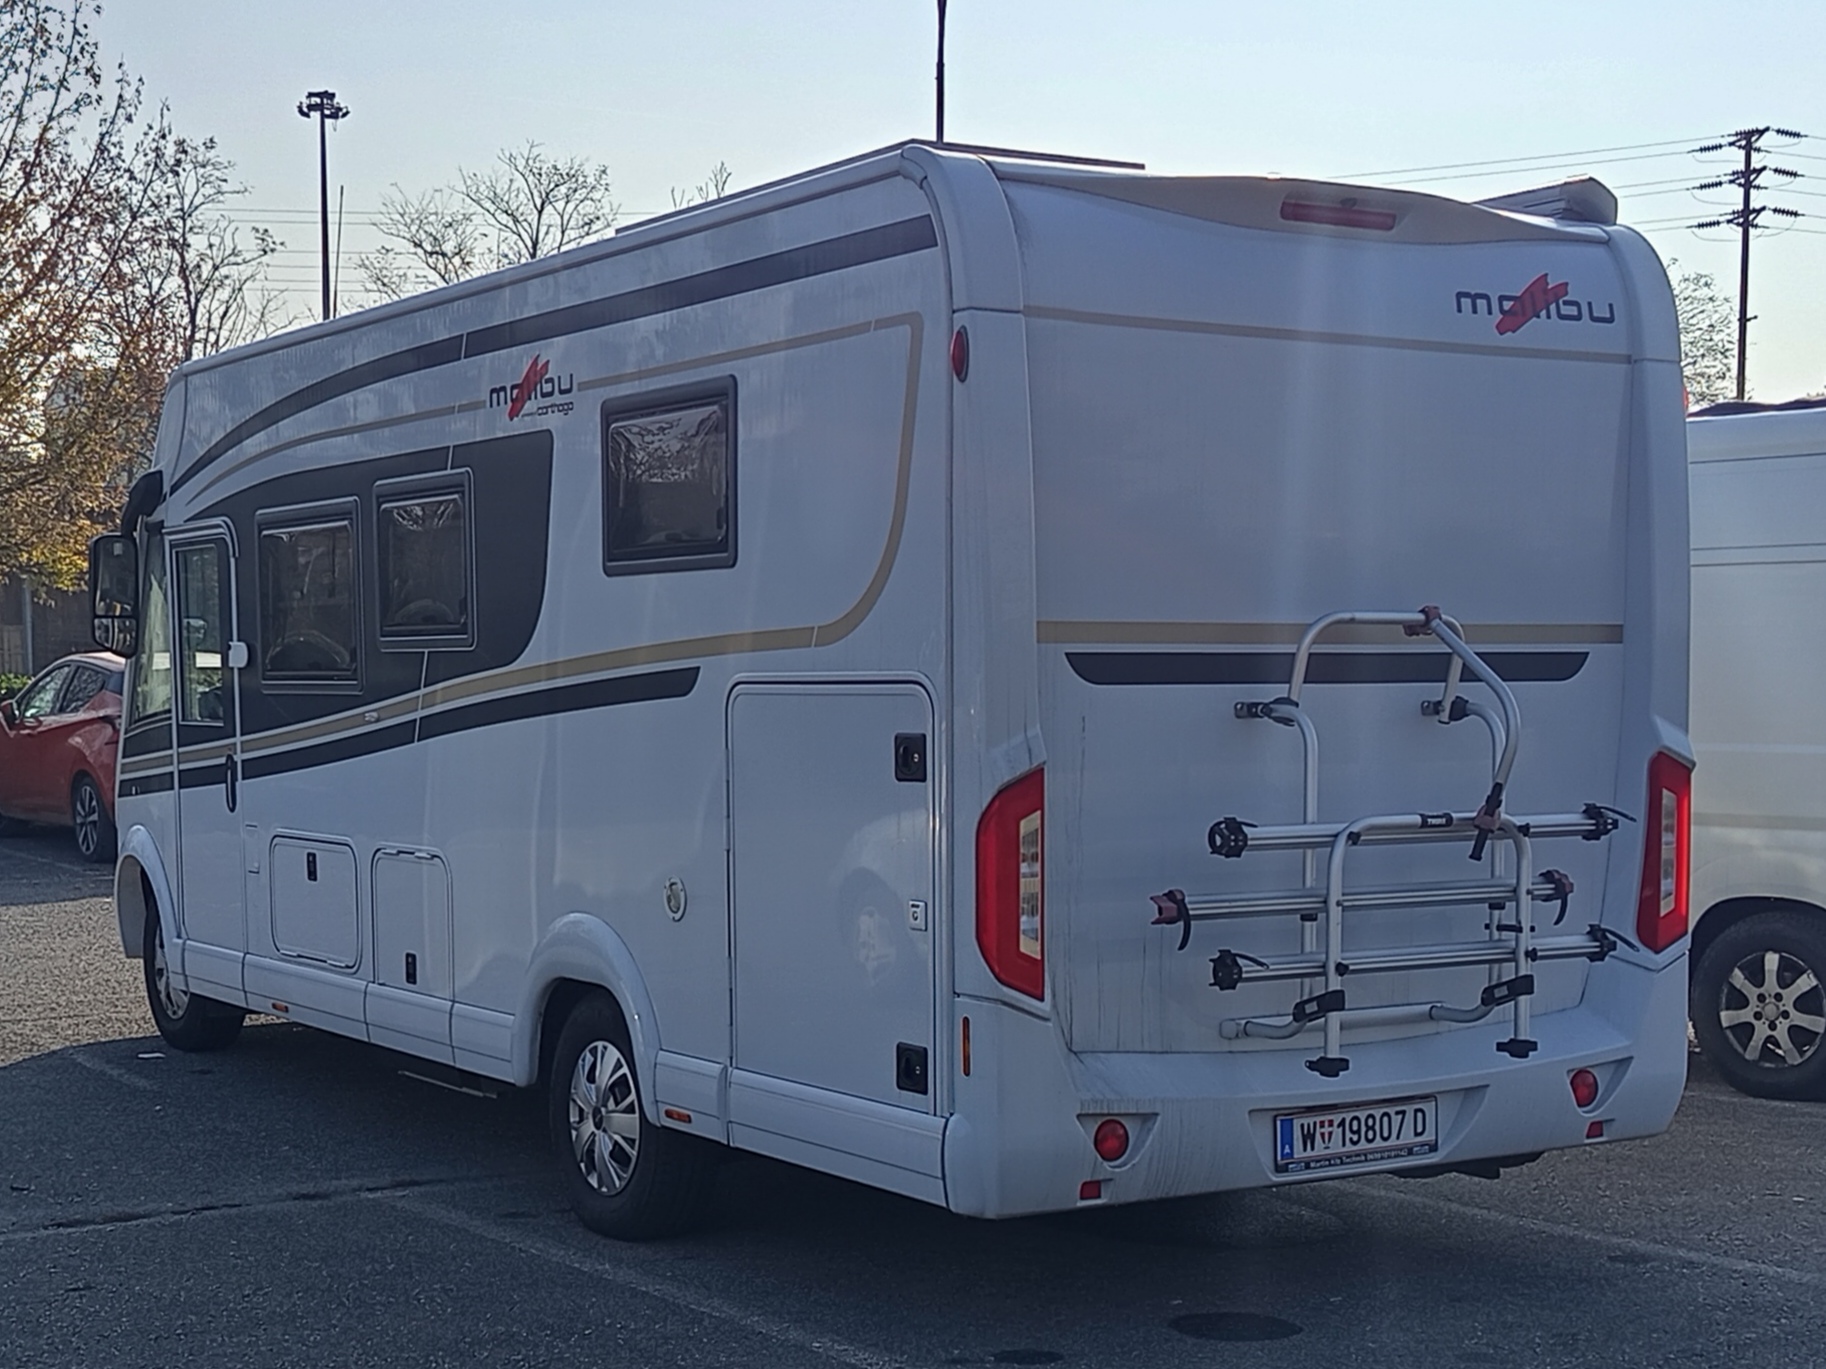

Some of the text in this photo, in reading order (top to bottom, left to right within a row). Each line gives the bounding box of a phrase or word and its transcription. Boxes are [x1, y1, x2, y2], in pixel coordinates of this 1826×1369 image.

[1300, 1107, 1426, 1152] W 19807 D
[1283, 1144, 1291, 1155] A
